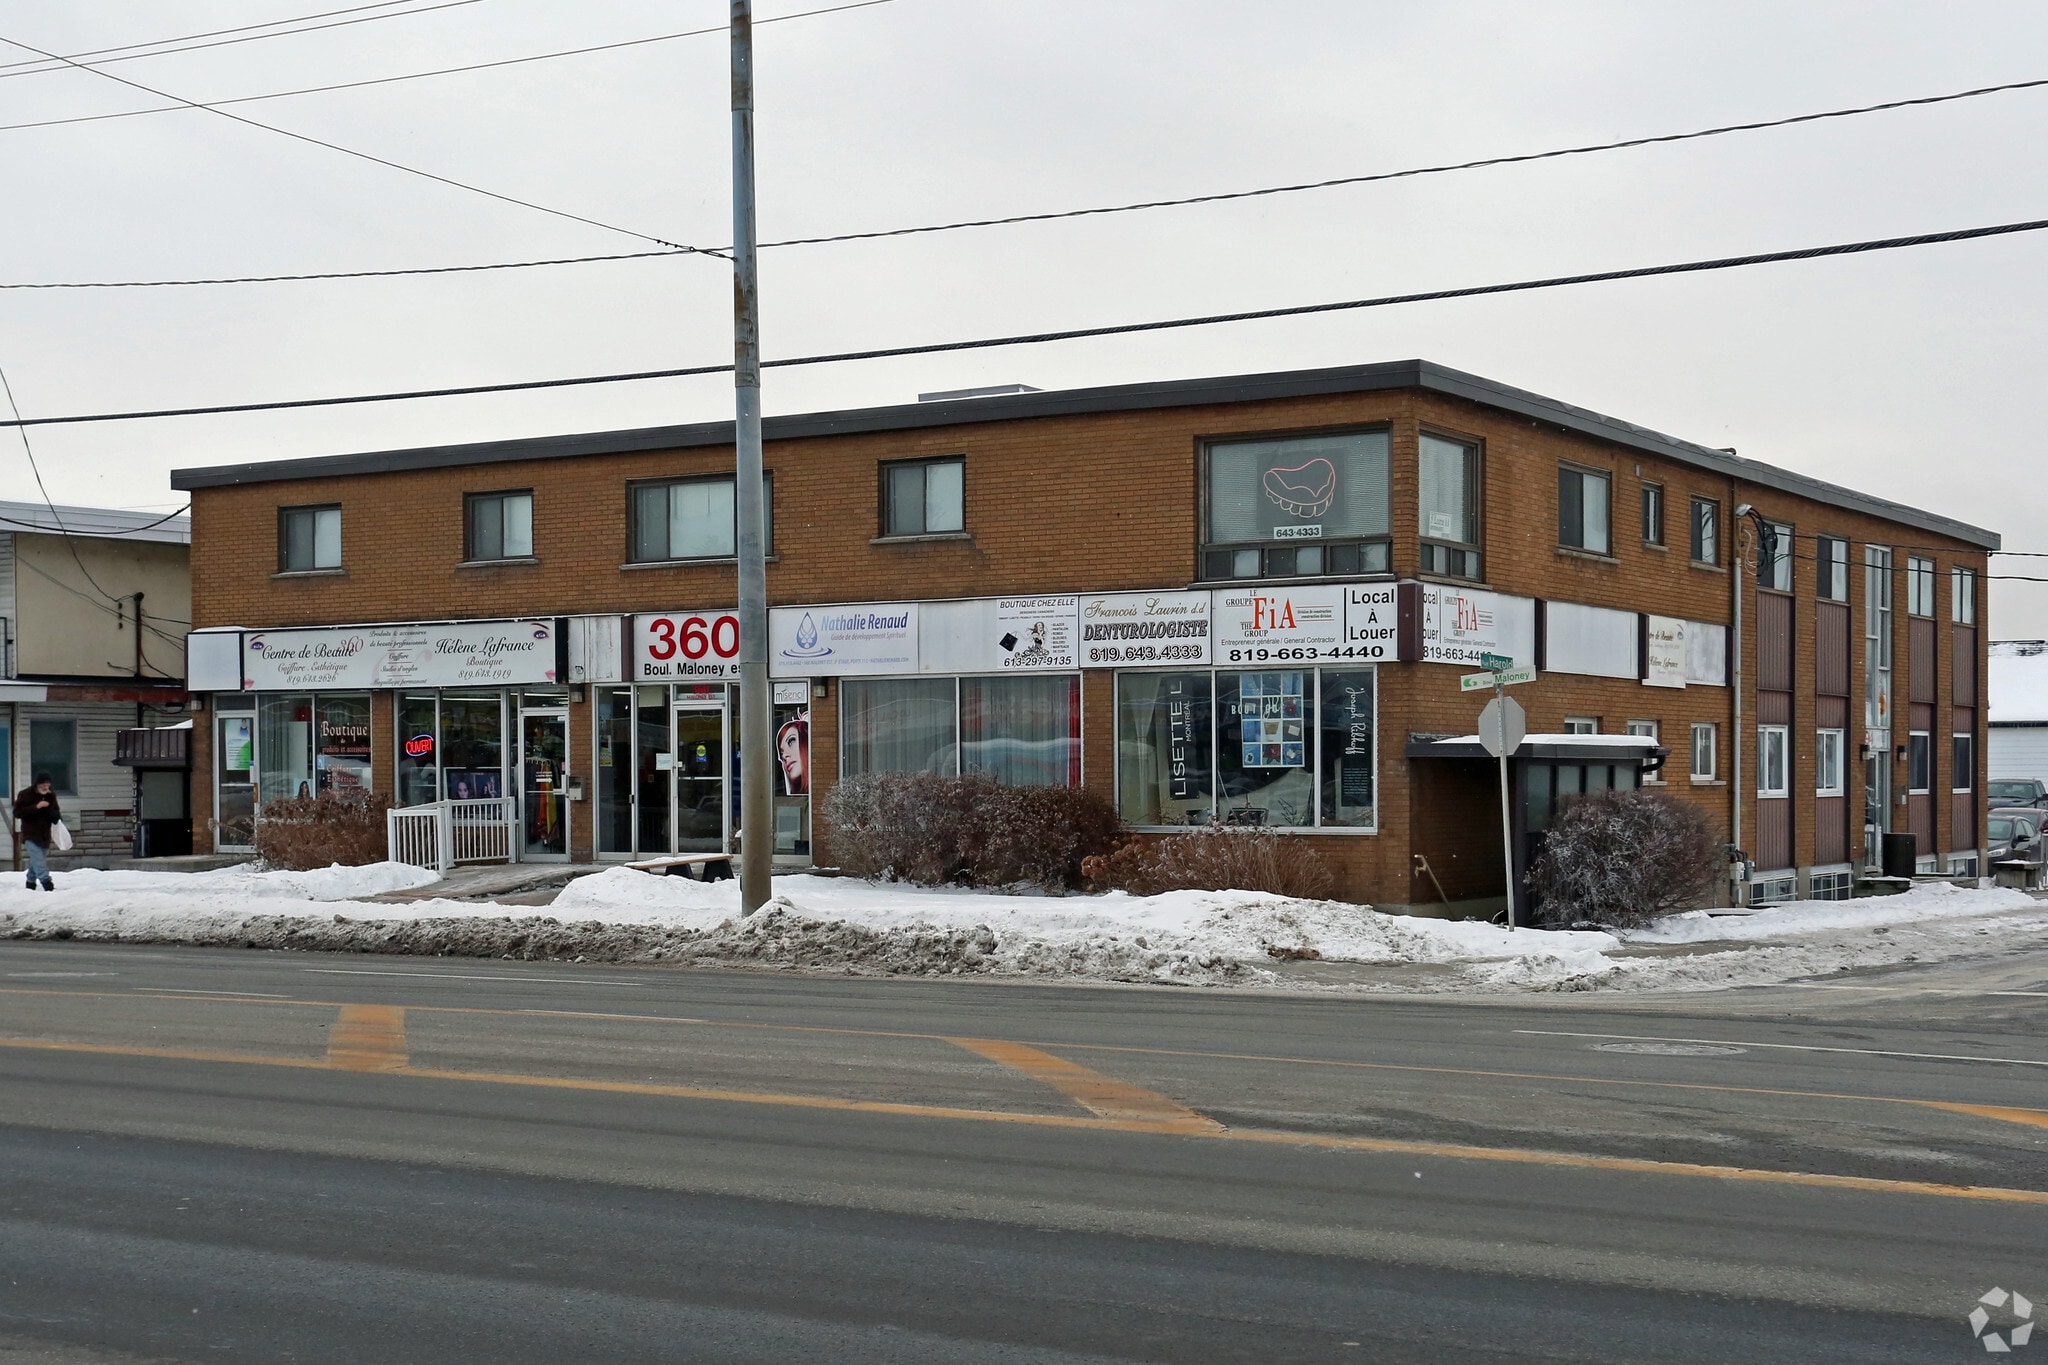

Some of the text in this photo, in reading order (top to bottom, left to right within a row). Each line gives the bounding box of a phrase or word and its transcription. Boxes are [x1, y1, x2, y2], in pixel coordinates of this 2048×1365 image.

[1000, 598, 1075, 609] BOUTIQUE CHEZ ELLE
[1351, 588, 1395, 605] Local
[1423, 590, 1438, 605] ocal
[1144, 597, 1188, 616] Laurin
[1253, 597, 1297, 629] FiA
[1457, 597, 1478, 631] FiA
[821, 611, 908, 631] Nathalie Renaud
[1368, 608, 1378, 624] À
[649, 616, 739, 660] 360
[831, 633, 845, 641] Guide
[1083, 619, 1209, 641] DENTUROLOGISTE
[1350, 626, 1395, 641] Louer
[1423, 629, 1439, 640] ouer
[435, 636, 535, 657] Hélène Lafrance
[1221, 638, 1256, 646] Entrepreneur
[262, 645, 295, 660] Centre
[298, 644, 311, 658] de
[1090, 645, 1203, 661] 819.643.4333
[1229, 646, 1384, 662] 819-663-4440
[278, 661, 348, 675] Coiffure Esthétique
[466, 656, 503, 669] Boutique
[1004, 656, 1072, 666] 613-297-9135
[1490, 657, 1513, 669] Harold
[458, 669, 512, 680] 819.643.1919
[644, 663, 672, 676] Boul.
[677, 663, 725, 676] Maloney
[1495, 672, 1530, 683] Maloney
[287, 674, 337, 686] 819.643.2626
[1345, 687, 1365, 719] Joseph
[1184, 700, 1192, 742] MONTRÉAL
[321, 721, 367, 742] Boutique
[1170, 681, 1186, 795] LISETTE L
[406, 738, 432, 753] OUVERT
